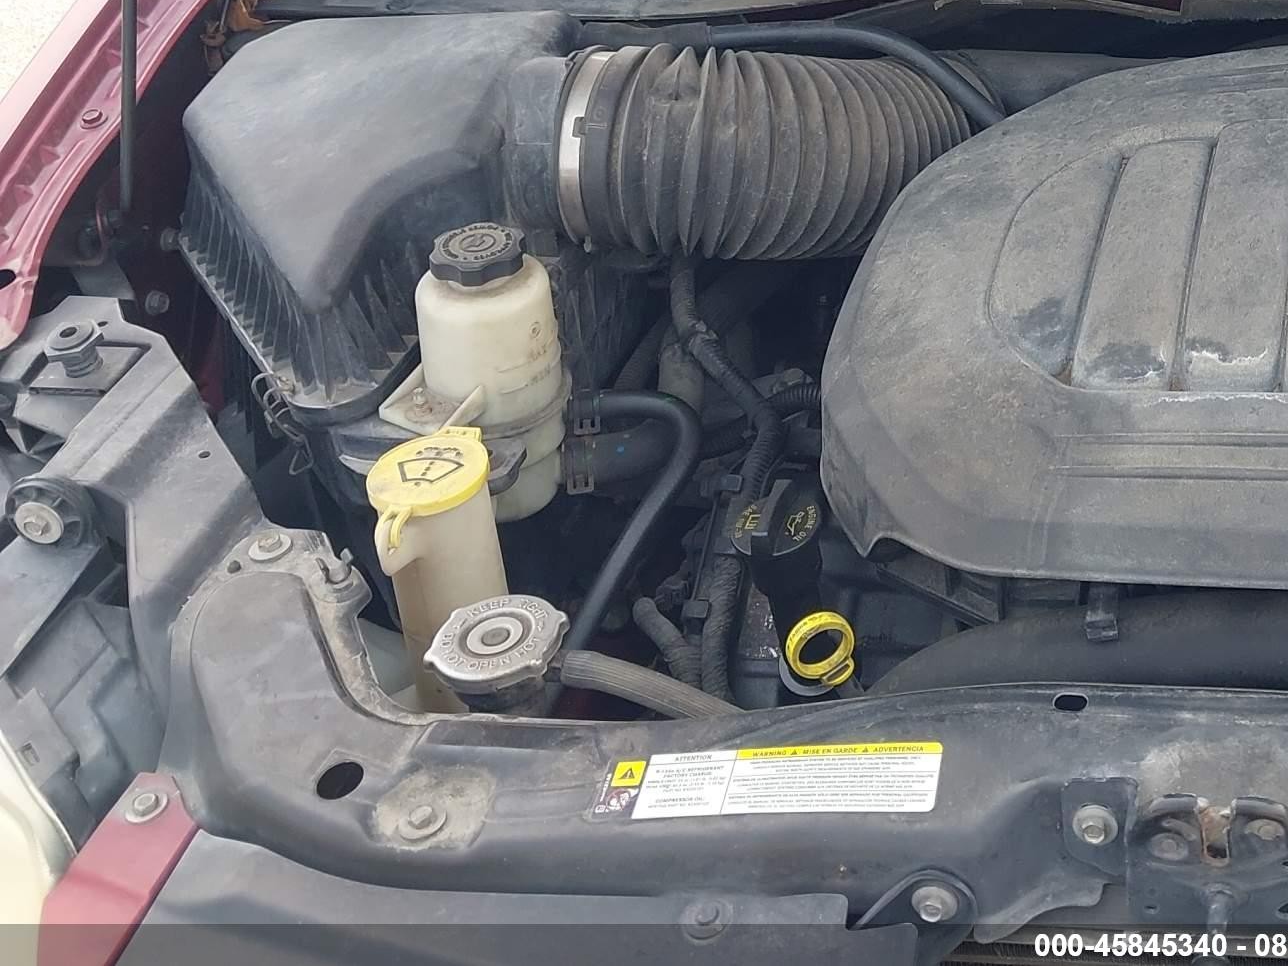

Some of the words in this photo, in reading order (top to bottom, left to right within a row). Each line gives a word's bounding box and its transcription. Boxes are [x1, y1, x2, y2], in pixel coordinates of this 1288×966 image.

[804, 505, 817, 530] ENGINE
[792, 531, 807, 542] OIL
[467, 598, 511, 617] KEEP
[467, 656, 512, 671] OPEN
[515, 636, 541, 659] HOT
[873, 745, 924, 753] ADVERTENCIA
[674, 754, 713, 762] ATTENTION
